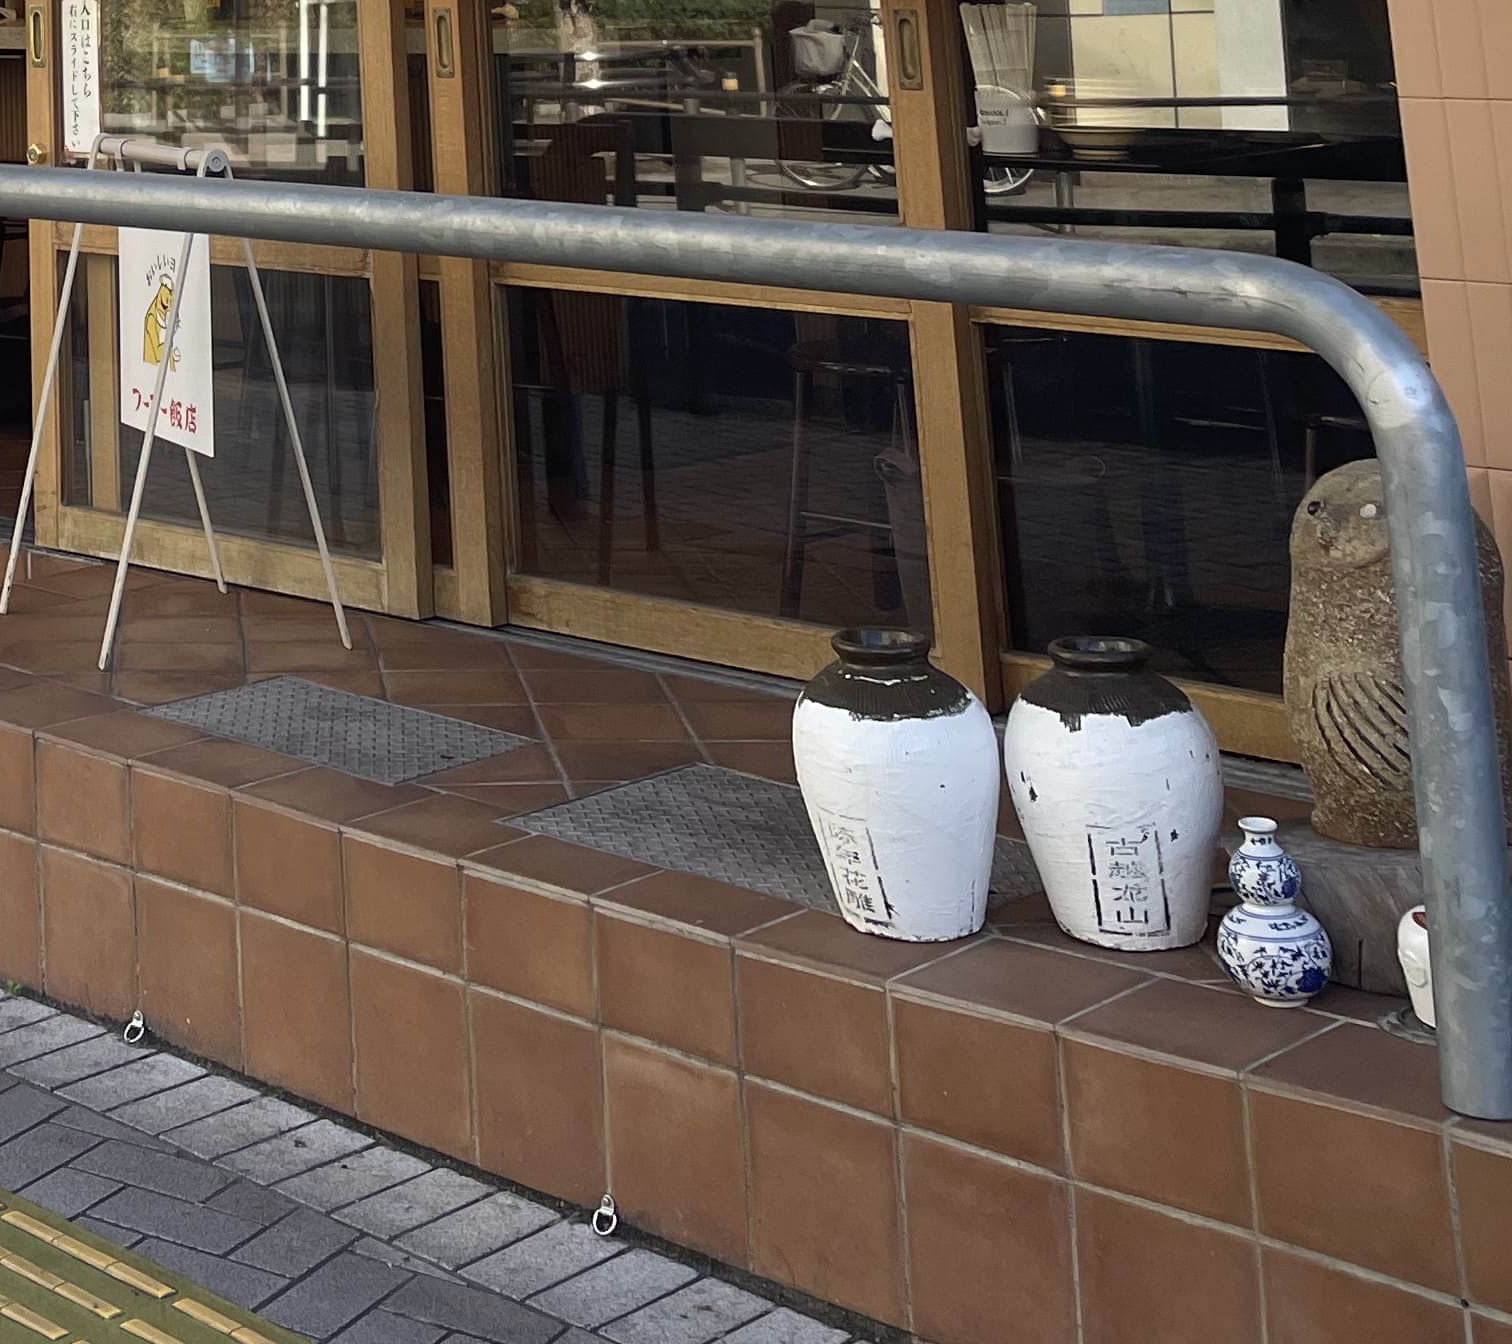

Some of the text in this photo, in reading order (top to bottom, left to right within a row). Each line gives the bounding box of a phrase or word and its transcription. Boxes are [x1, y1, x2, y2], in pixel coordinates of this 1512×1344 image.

[68, 2, 82, 148] 右にスライドして下さい
[131, 387, 198, 435] フーー飯店
